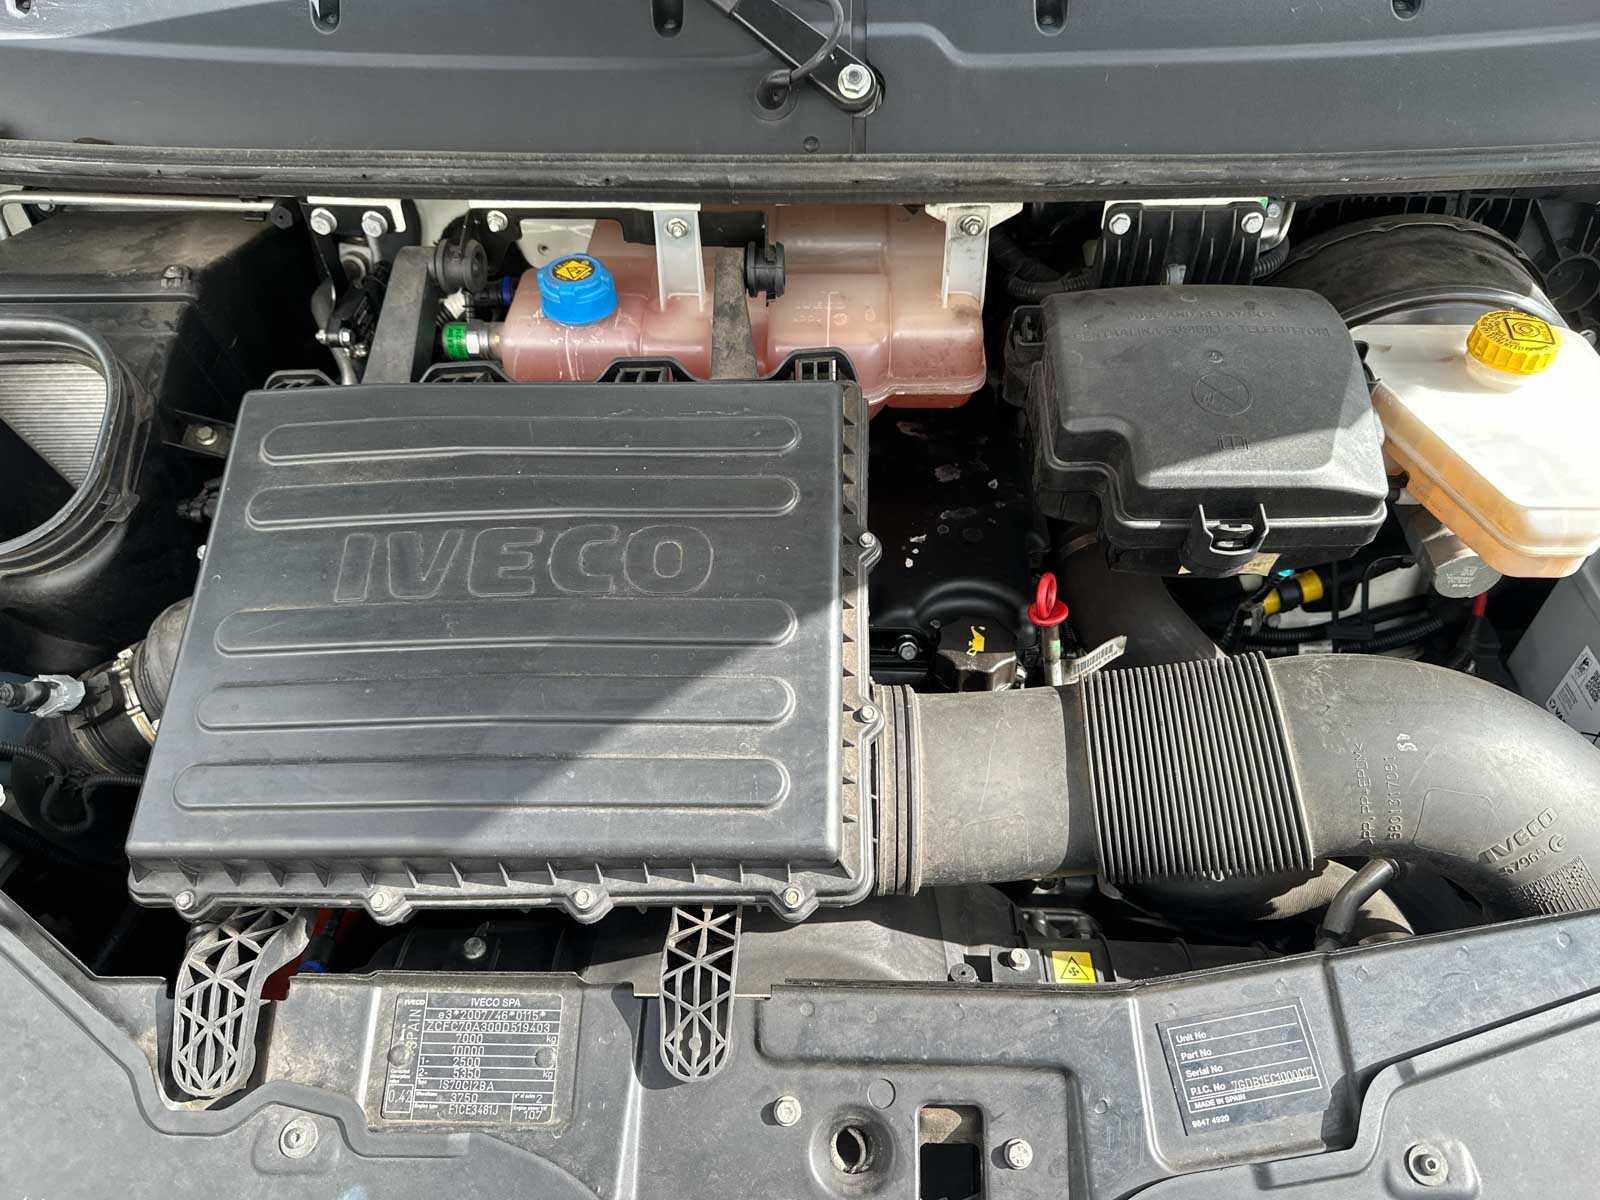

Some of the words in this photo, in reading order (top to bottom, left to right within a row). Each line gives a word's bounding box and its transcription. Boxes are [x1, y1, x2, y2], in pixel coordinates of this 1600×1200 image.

[333, 523, 714, 603] IVECO
[1478, 807, 1559, 864] IVECO
[471, 997, 500, 1007] IVECO
[502, 998, 521, 1008] SPA
[455, 1033, 484, 1044] 7000
[546, 1034, 557, 1045] kg
[1175, 1034, 1194, 1043] Unit
[1194, 1031, 1207, 1040] No
[451, 1046, 485, 1056] 10000
[1180, 1051, 1199, 1061] Part
[1199, 1049, 1212, 1057] No
[452, 1057, 481, 1067] 2500
[452, 1068, 481, 1079] 5350
[543, 1070, 554, 1080] kg
[1185, 1066, 1210, 1078] Serial
[1210, 1064, 1223, 1074] No
[1213, 1082, 1226, 1092] No
[450, 1092, 478, 1103] 3750
[536, 1094, 543, 1104] 2
[1194, 1099, 1216, 1109] MADE
[1225, 1094, 1246, 1104] SPAIN
[523, 1110, 543, 1120] 107
